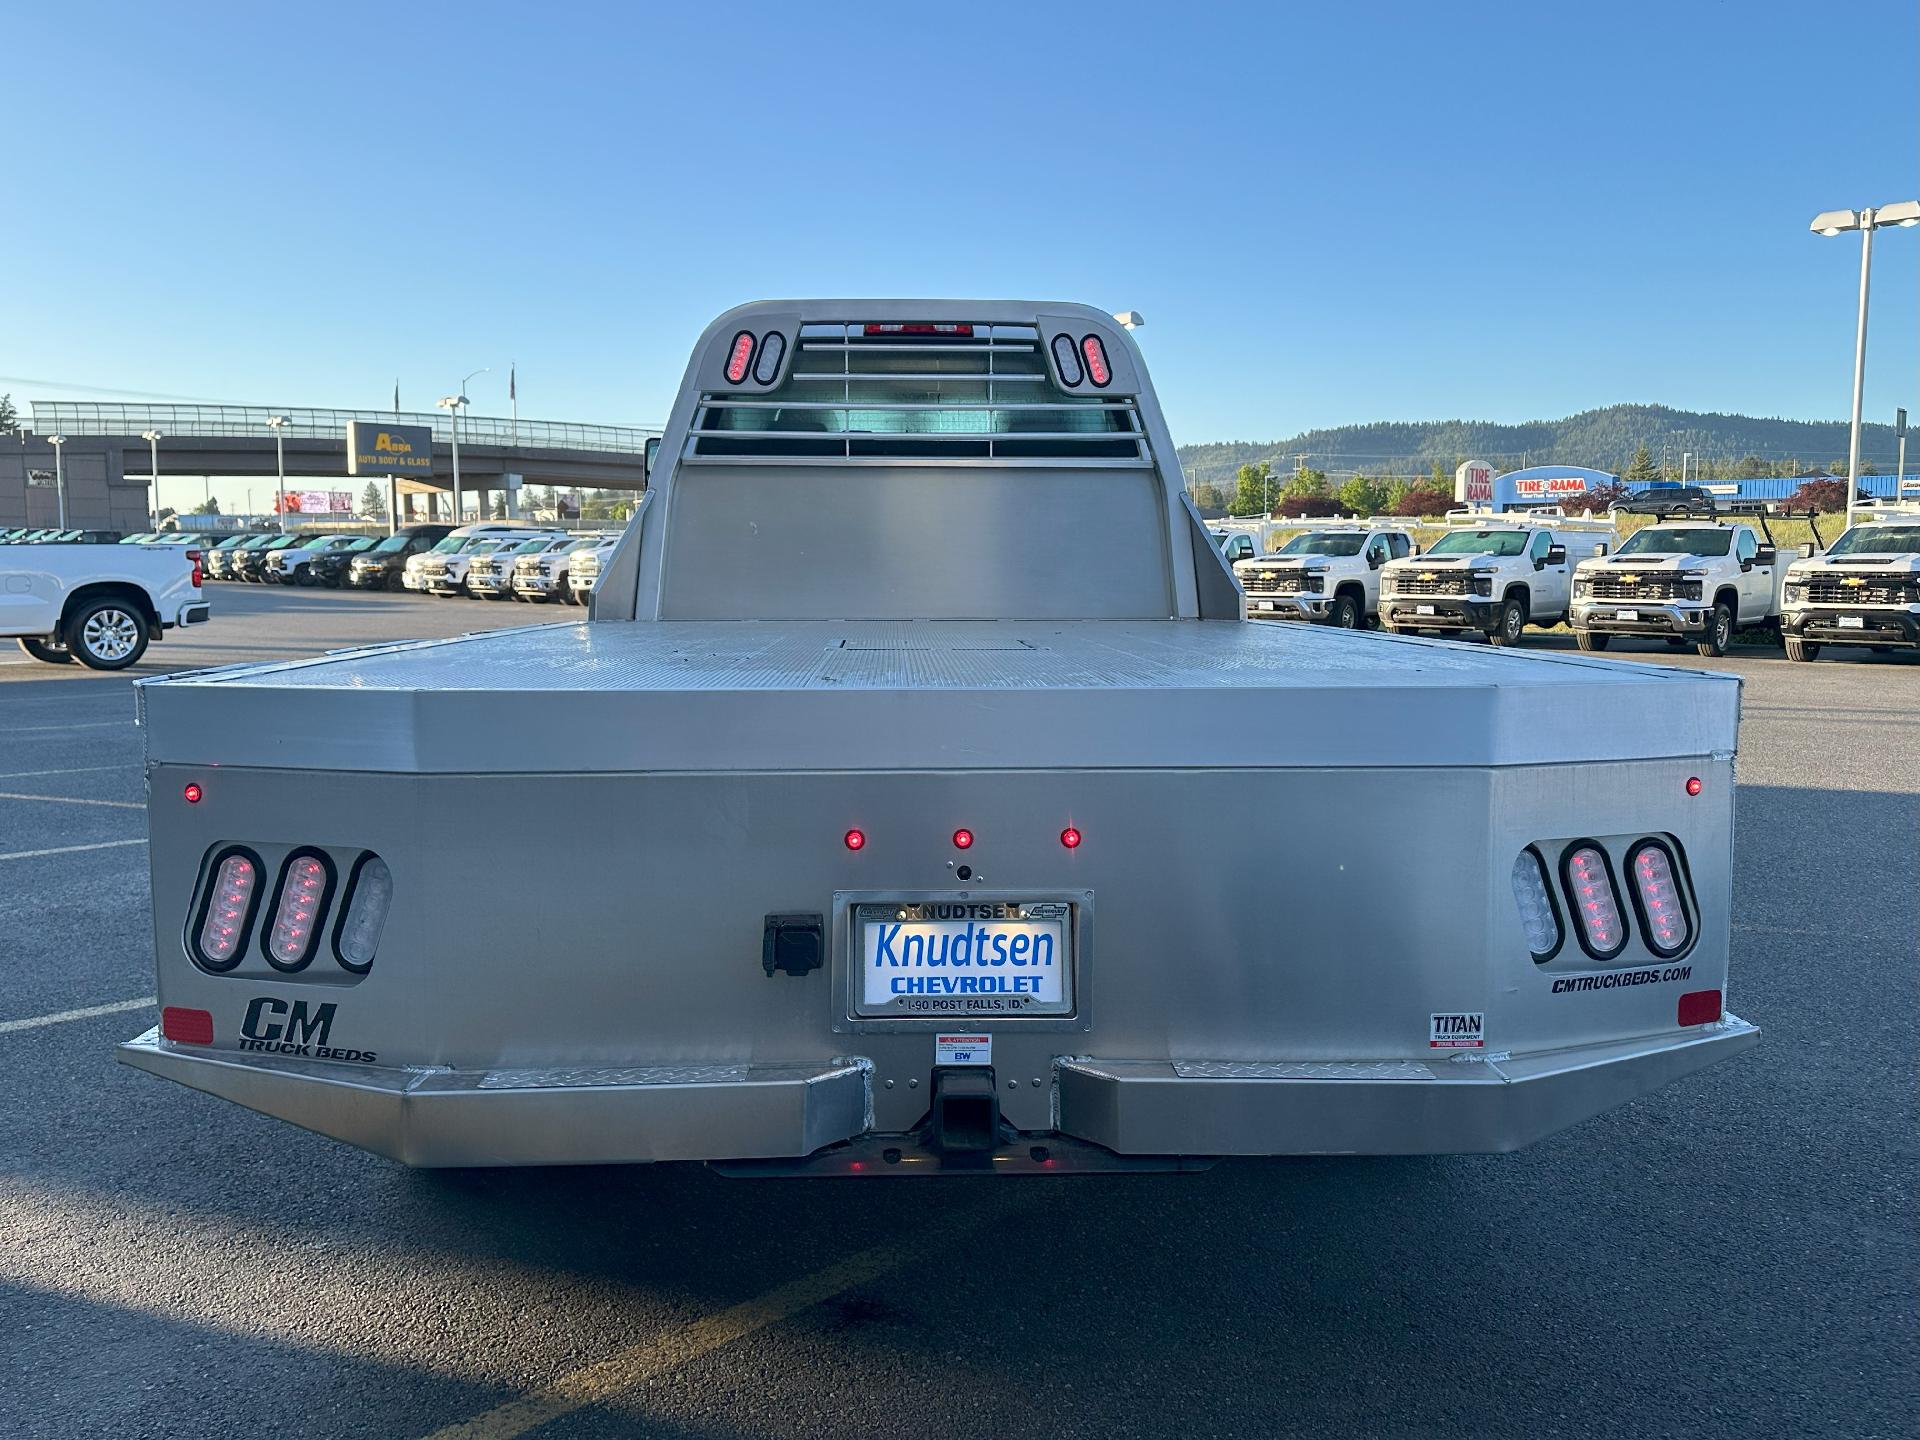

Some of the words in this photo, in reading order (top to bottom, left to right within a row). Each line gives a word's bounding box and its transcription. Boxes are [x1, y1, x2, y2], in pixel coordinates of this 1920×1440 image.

[358, 455, 377, 464] AUTO
[379, 456, 398, 465] BODY
[400, 457, 405, 465] &
[408, 458, 430, 466] GLASS
[1470, 467, 1490, 483] TIRE
[1467, 484, 1493, 501] RAMA
[906, 904, 1019, 919] KNUDTSEN
[875, 923, 1054, 967] Knudtsen
[891, 976, 1043, 994] CHEVROLET
[1552, 966, 1692, 993] CMTRUCKBEDS.COM
[908, 1000, 929, 1010] I-90
[932, 1000, 963, 1010] POST
[966, 999, 1005, 1011] FALLS,
[1008, 999, 1023, 1010] ID.
[240, 997, 338, 1046] CM
[239, 1039, 311, 1056] TRUCK
[315, 1046, 377, 1062] BEDS
